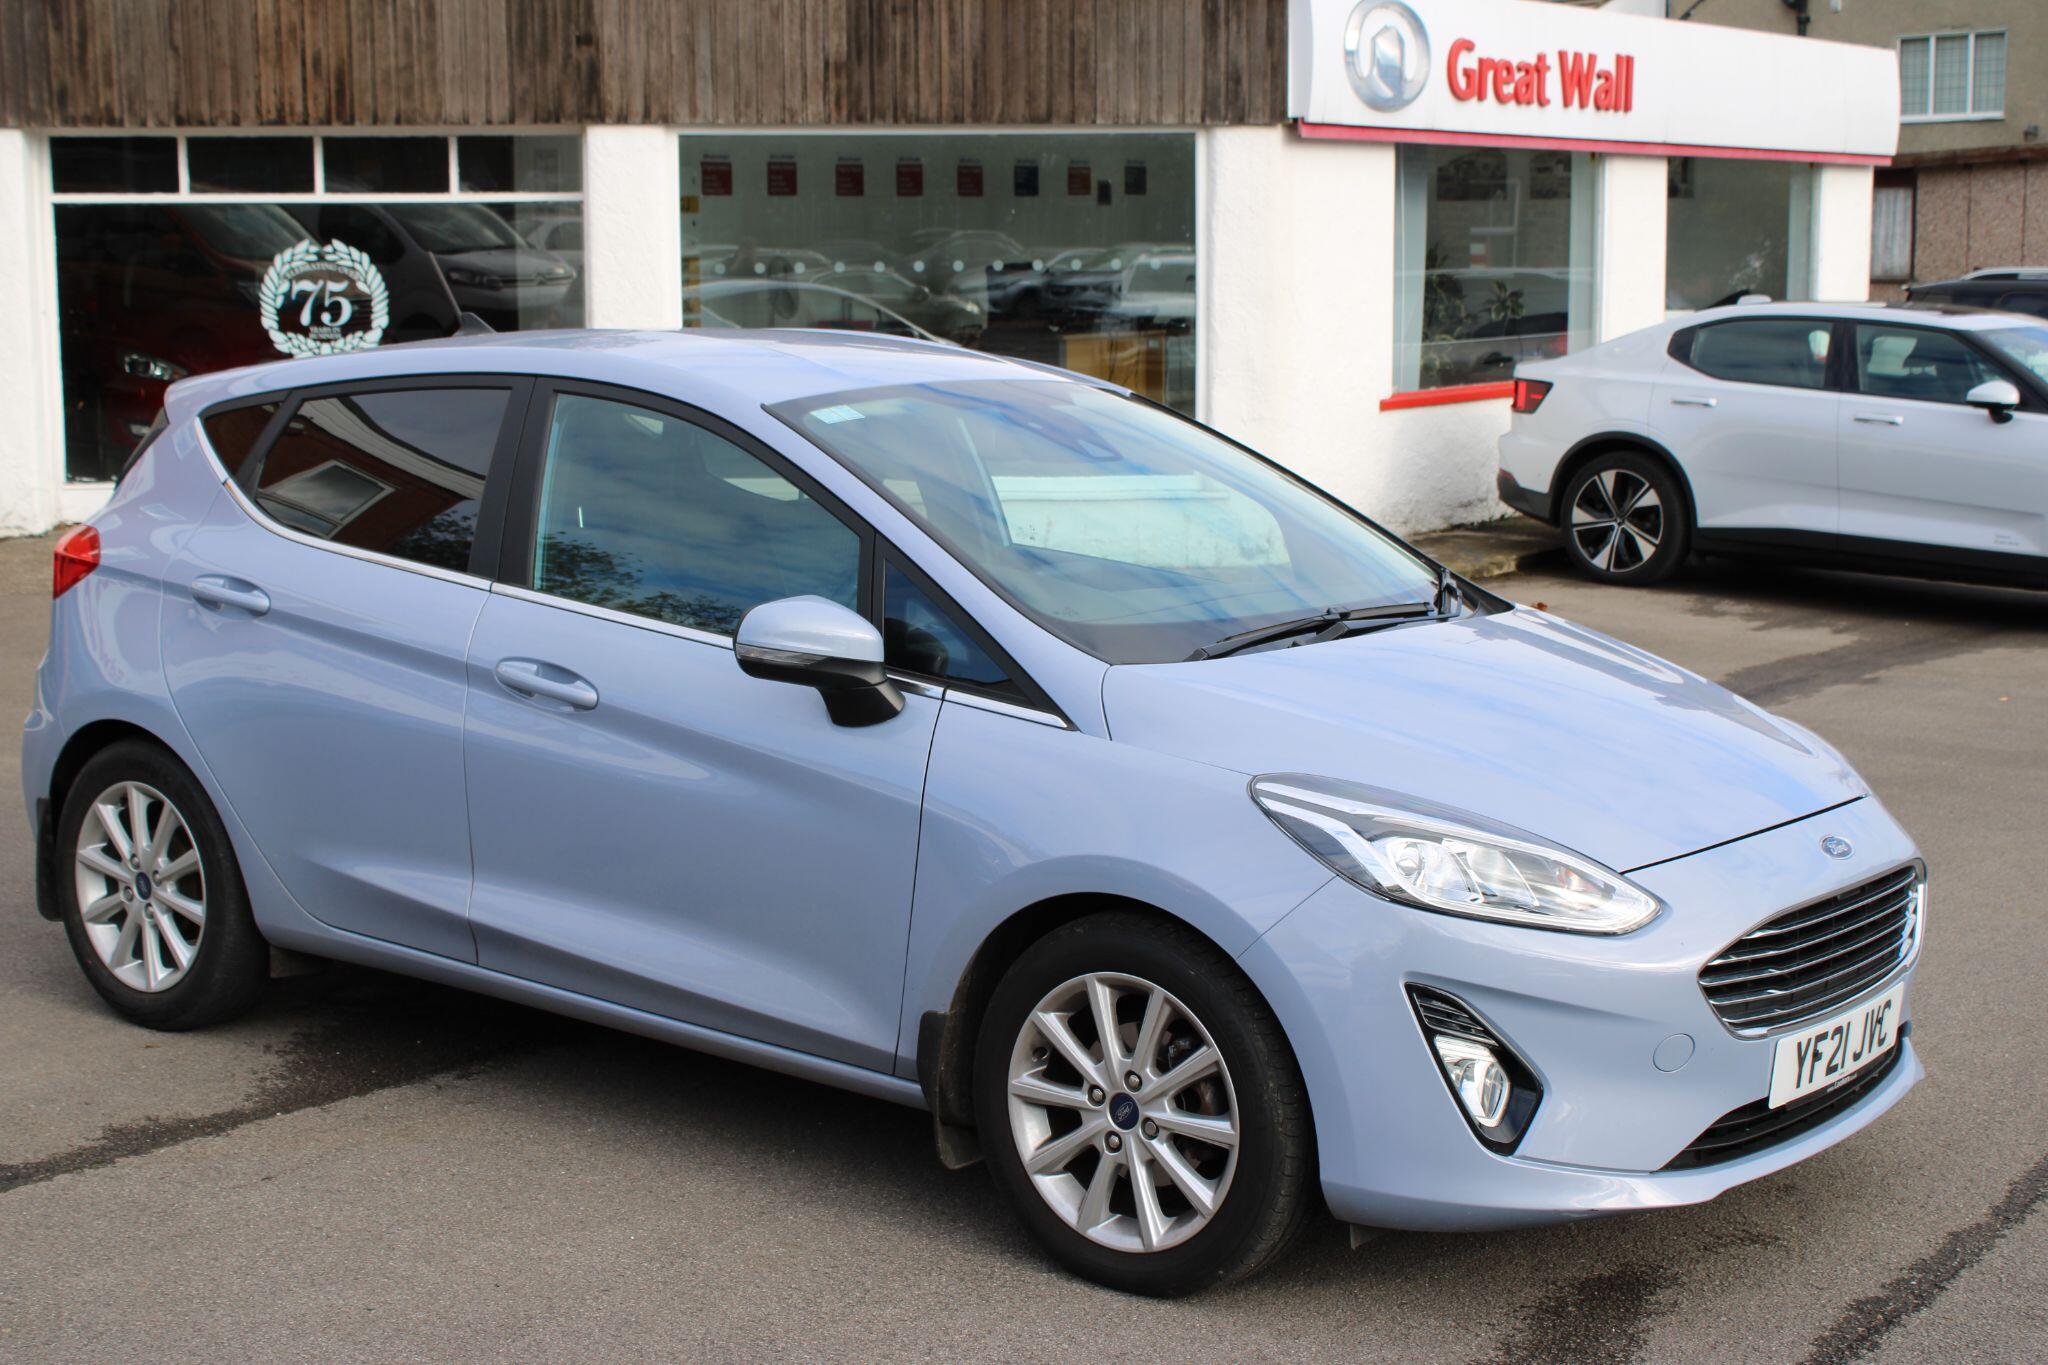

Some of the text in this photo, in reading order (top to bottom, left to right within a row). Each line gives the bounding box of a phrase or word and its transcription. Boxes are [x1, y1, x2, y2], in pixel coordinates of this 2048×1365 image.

[1447, 38, 1634, 113] Great Wall
[291, 280, 352, 327] 75
[1826, 839, 1850, 855] Ford
[1795, 999, 1892, 1088] YF21 JVC
